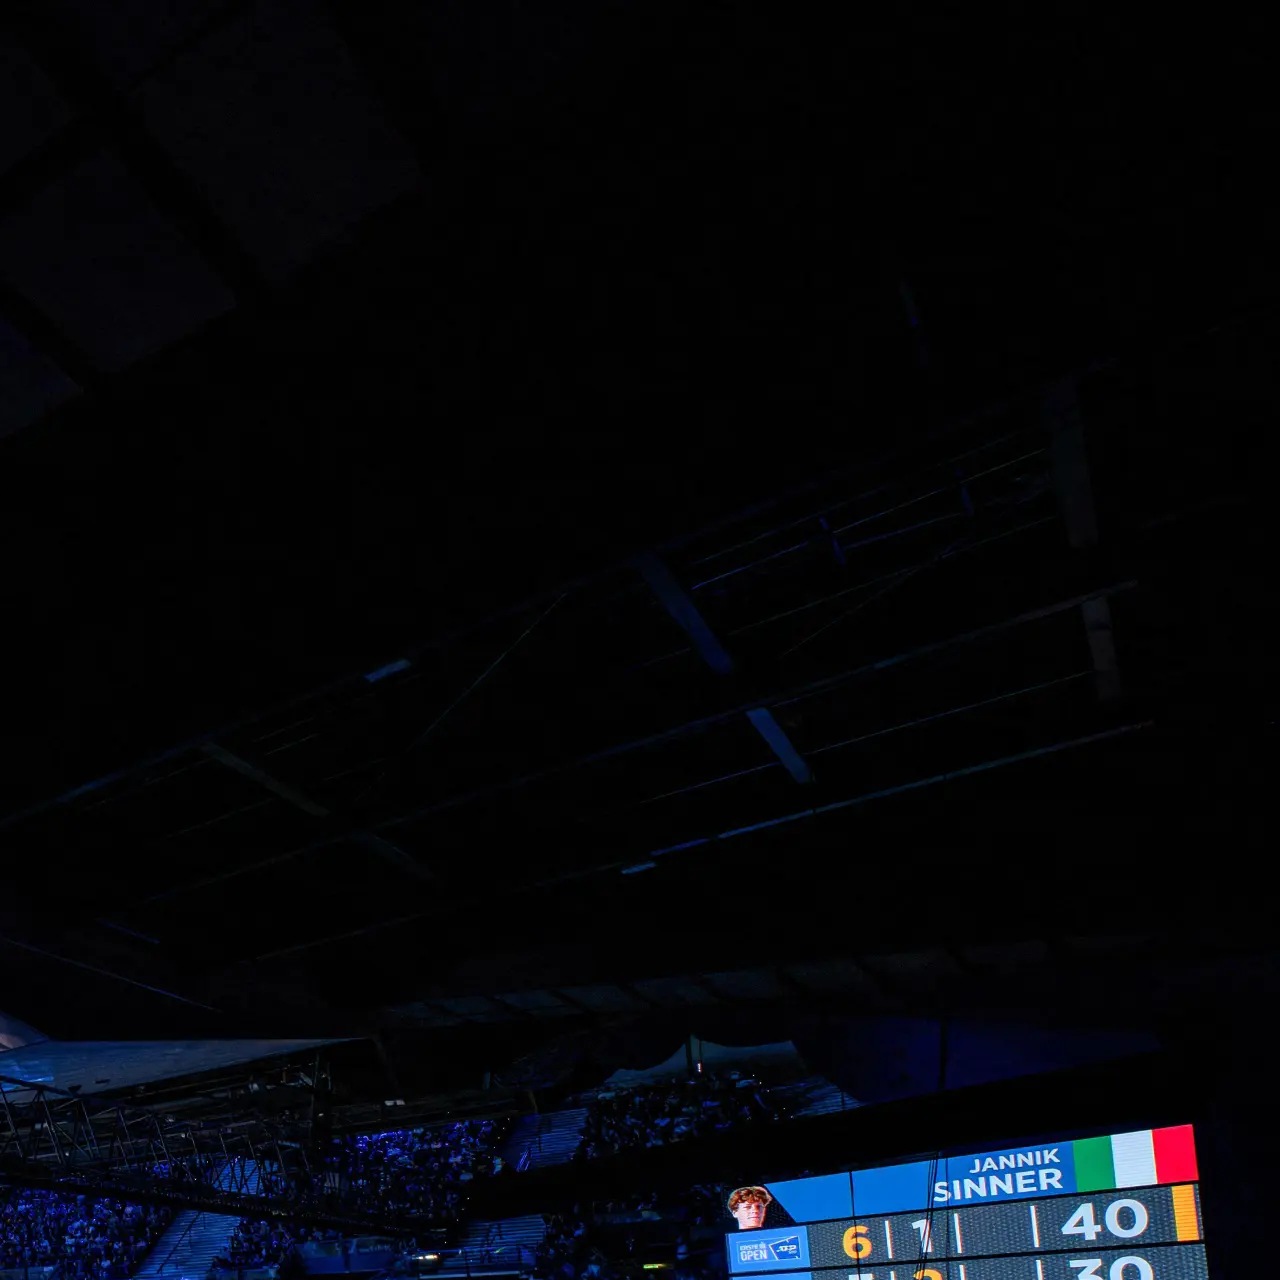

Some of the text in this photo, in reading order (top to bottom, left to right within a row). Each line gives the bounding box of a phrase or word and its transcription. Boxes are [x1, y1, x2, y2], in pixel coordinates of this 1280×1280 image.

[969, 1147, 1061, 1174] JANNIK
[933, 1167, 1064, 1202] SINNER
[842, 1199, 1149, 1259] 6 1 40
[740, 1249, 769, 1261] OPEN
